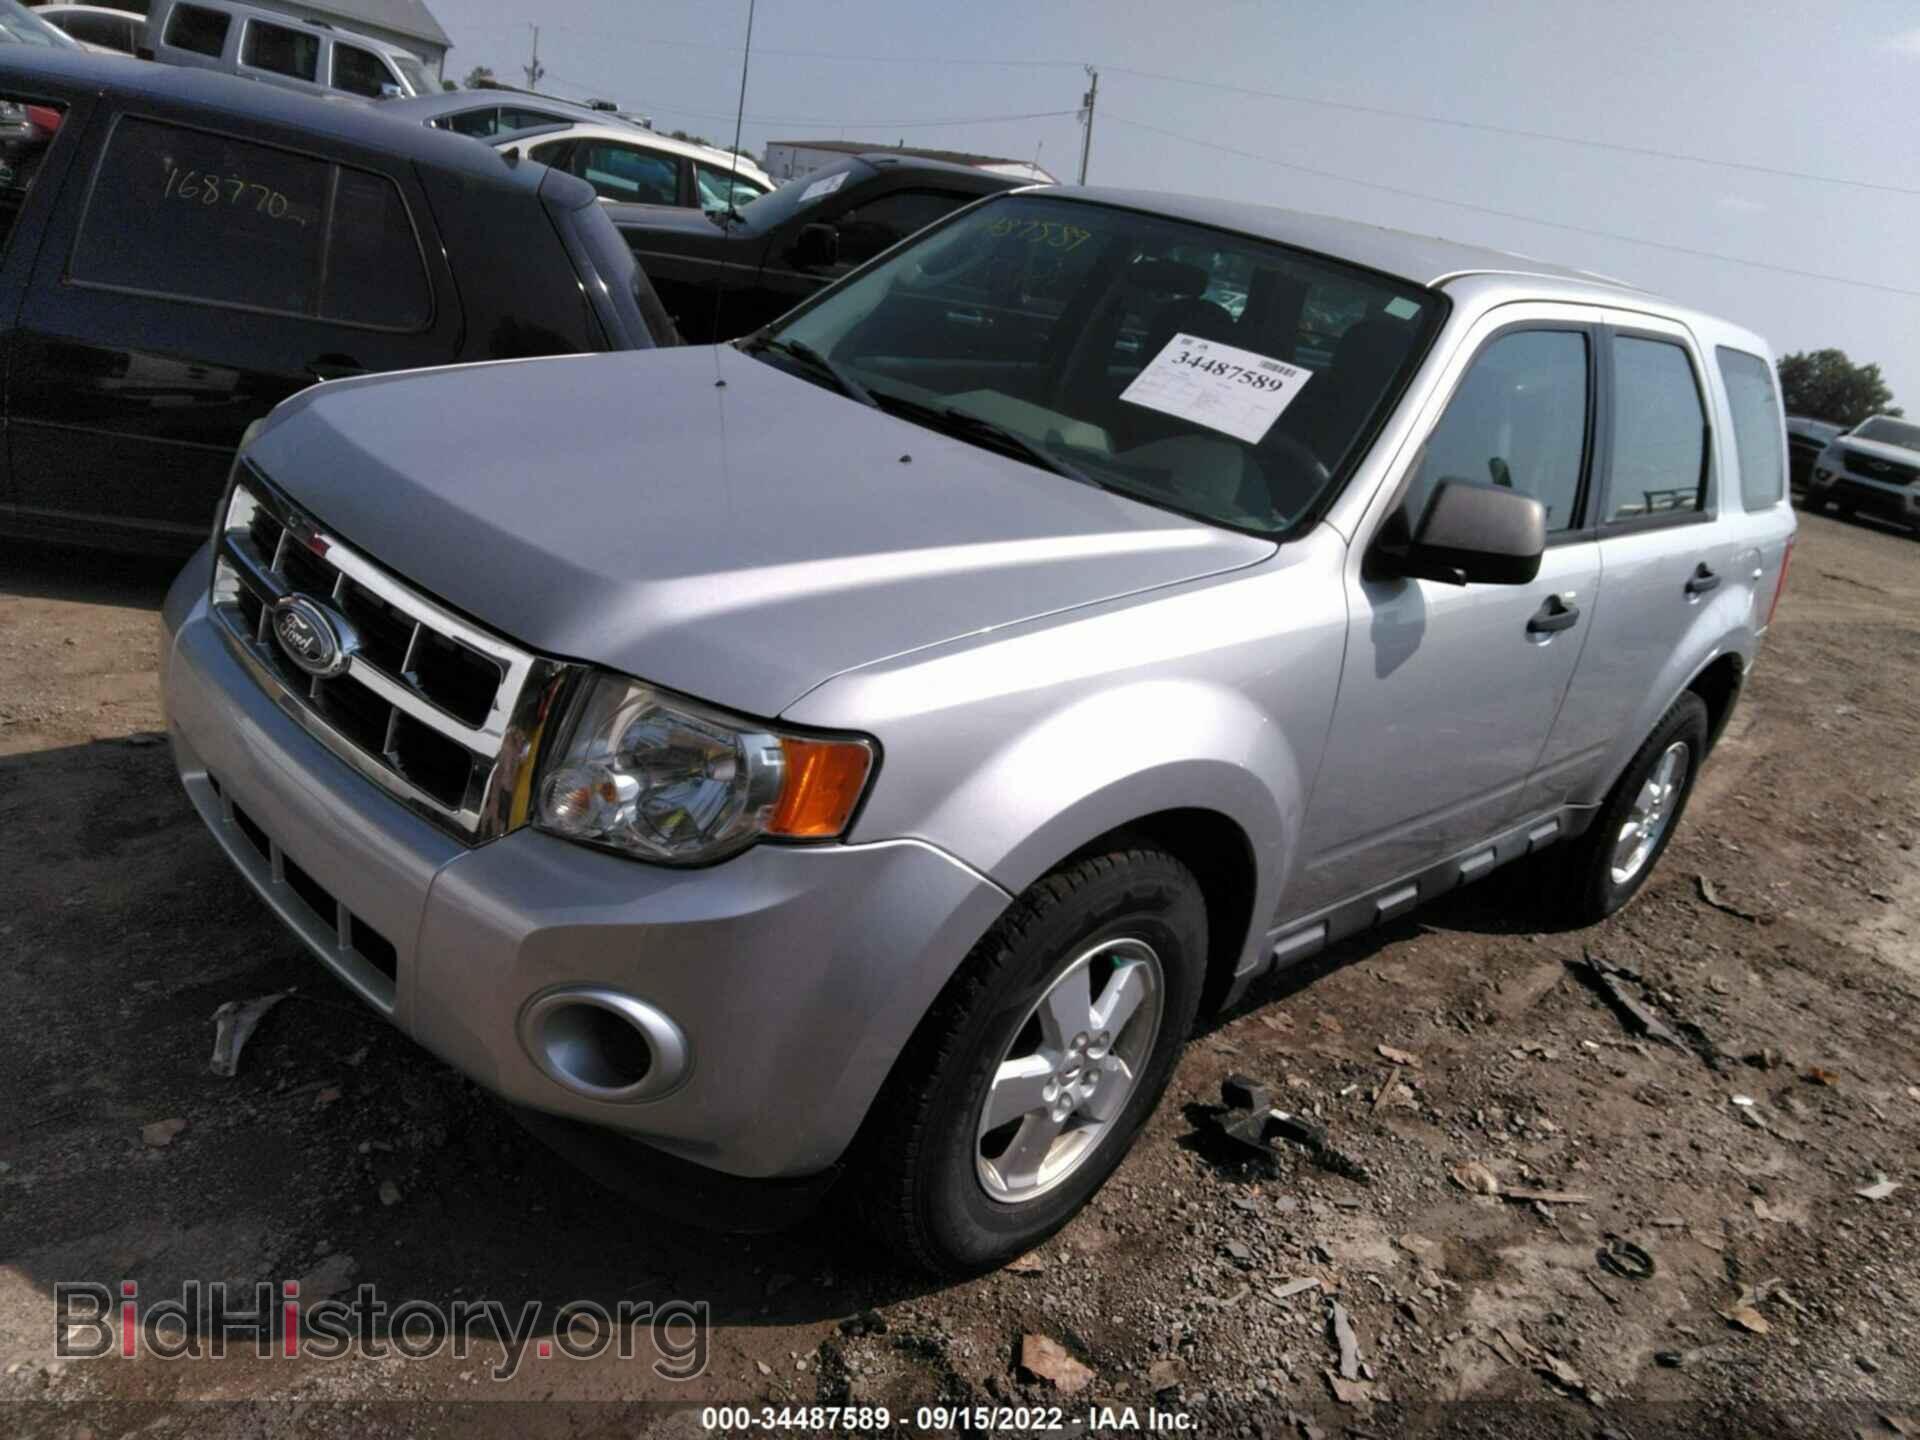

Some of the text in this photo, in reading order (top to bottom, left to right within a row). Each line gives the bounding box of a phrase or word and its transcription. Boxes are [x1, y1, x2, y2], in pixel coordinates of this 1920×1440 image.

[164, 165, 288, 218] 168770
[1171, 350, 1284, 393] 34487589
[279, 612, 315, 655] Ford
